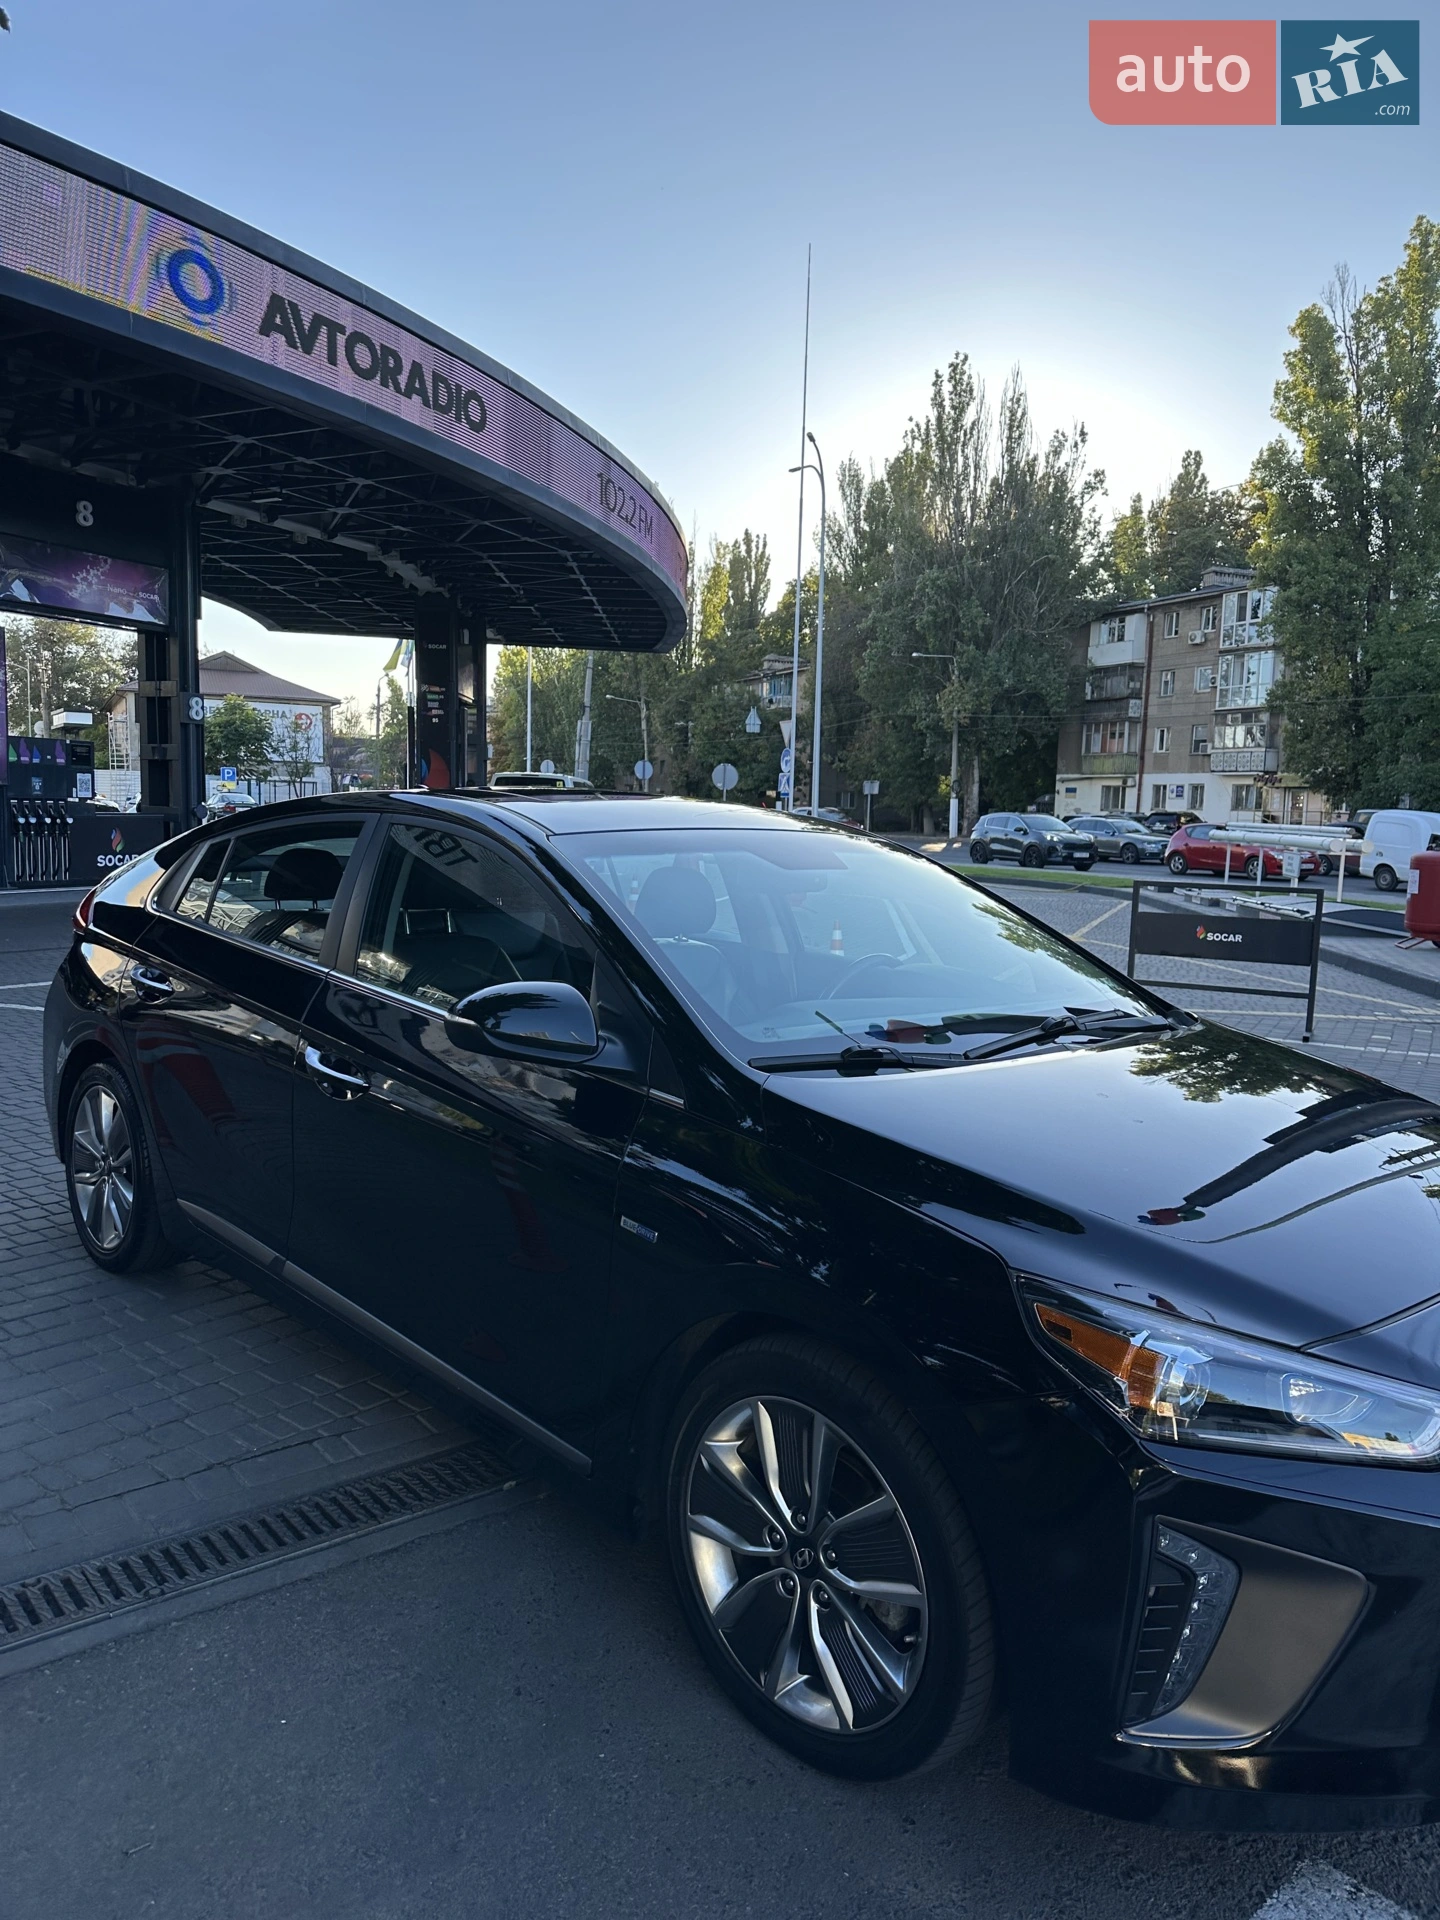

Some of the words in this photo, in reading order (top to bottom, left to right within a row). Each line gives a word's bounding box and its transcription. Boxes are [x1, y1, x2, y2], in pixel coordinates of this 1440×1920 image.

[259, 292, 487, 433] AVTORADIO
[76, 500, 94, 527] 8
[188, 696, 204, 721] 8
[224, 769, 233, 781] P
[1206, 932, 1243, 943] SOCAR
